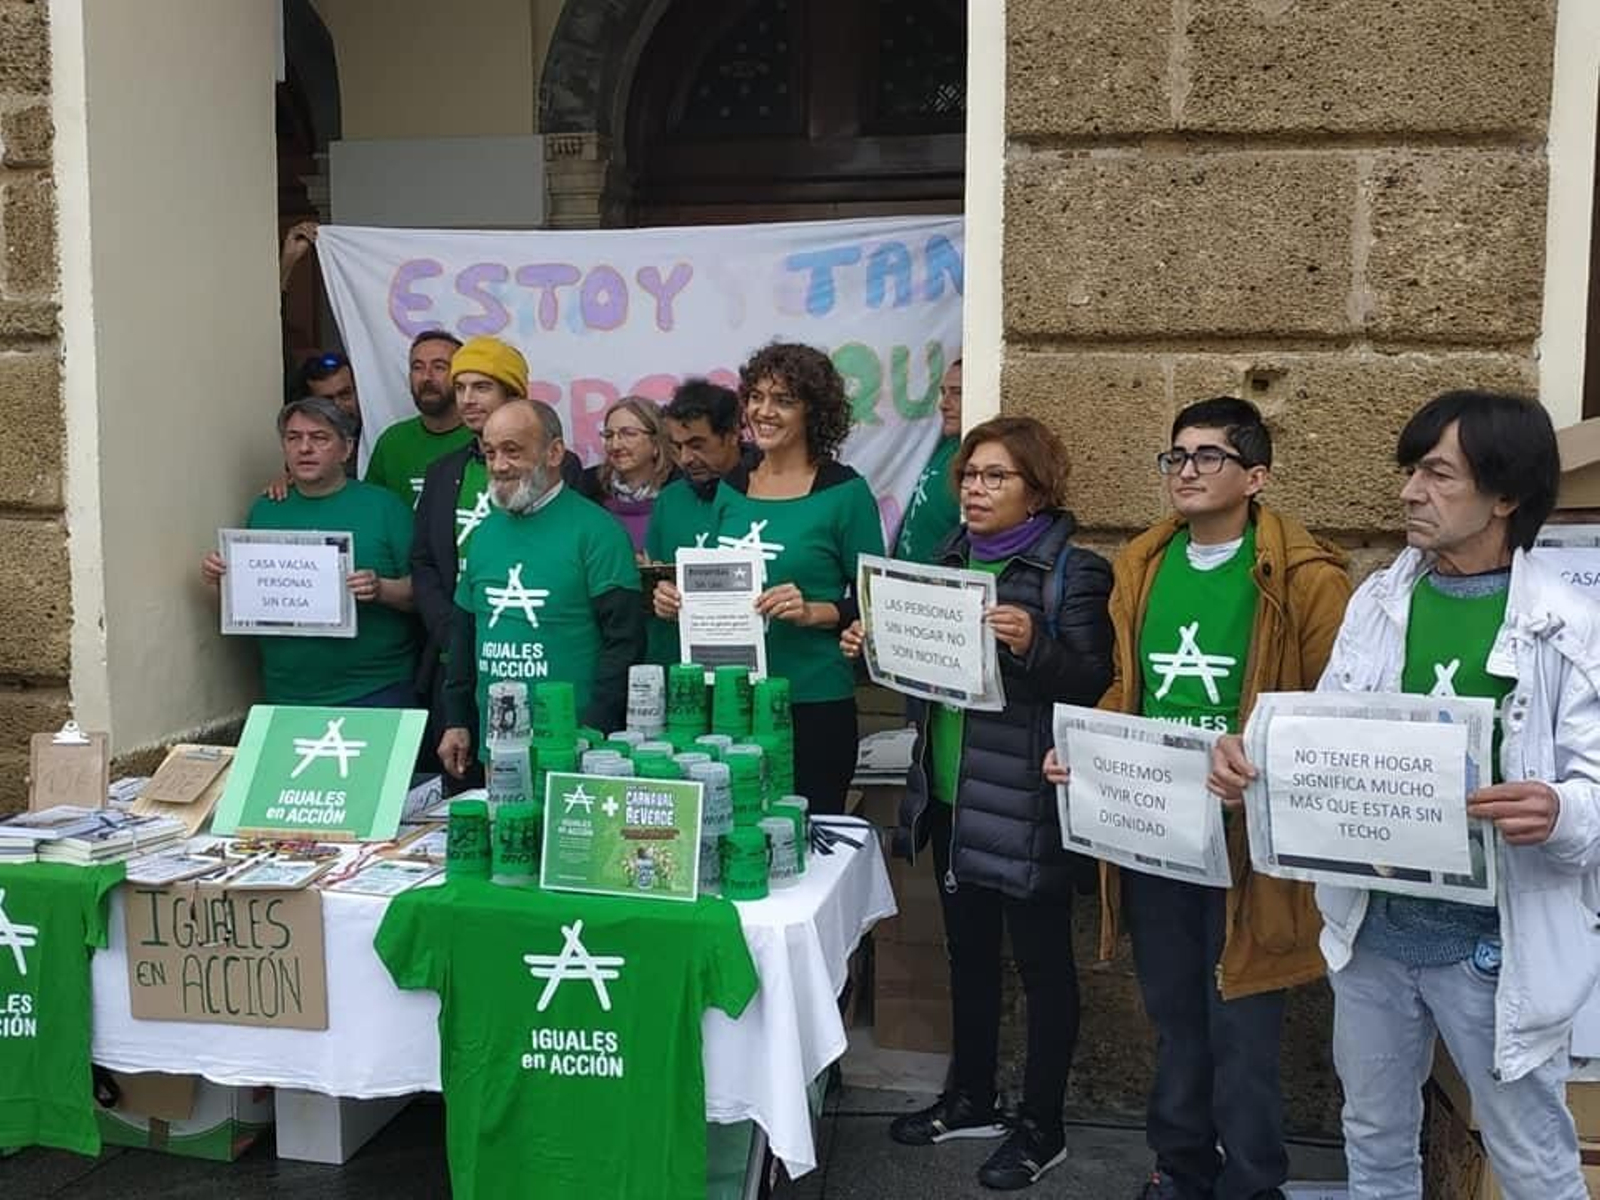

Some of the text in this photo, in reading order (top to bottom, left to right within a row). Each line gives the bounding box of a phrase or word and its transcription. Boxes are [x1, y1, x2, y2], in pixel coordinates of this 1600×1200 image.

[388, 233, 963, 338] ESTOY TAN
[831, 340, 945, 426] QU
[248, 559, 276, 569] CASA
[257, 577, 314, 588] PERSONAS
[262, 597, 309, 608] SIN CASA
[884, 599, 963, 623] LAS PERSONAS
[885, 622, 966, 646] SIN HOGAR NO
[482, 642, 544, 659] IGUALES
[892, 644, 961, 669] SON NOTICIA
[490, 657, 548, 678] ACCIÓN
[1093, 756, 1173, 784] QUEREMOS
[1294, 749, 1434, 773] NO TENER HOGAR
[279, 789, 347, 806] IGUALES
[1098, 783, 1167, 811] VIVIR CON
[1292, 773, 1435, 799] SIGNIFICA MUCHO
[285, 804, 346, 825] ACCIÓN
[1327, 797, 1358, 816] QUE
[1363, 802, 1412, 820] ESTAR
[1415, 807, 1443, 823] SIN
[1099, 809, 1166, 838] DIGNIDAD
[1338, 822, 1391, 841] TECHO
[136, 890, 291, 950] IGUALES
[136, 950, 302, 1018] EN ACCIÓN
[532, 1028, 618, 1053] IGUALES
[521, 1049, 624, 1078] en ACCIÓN
